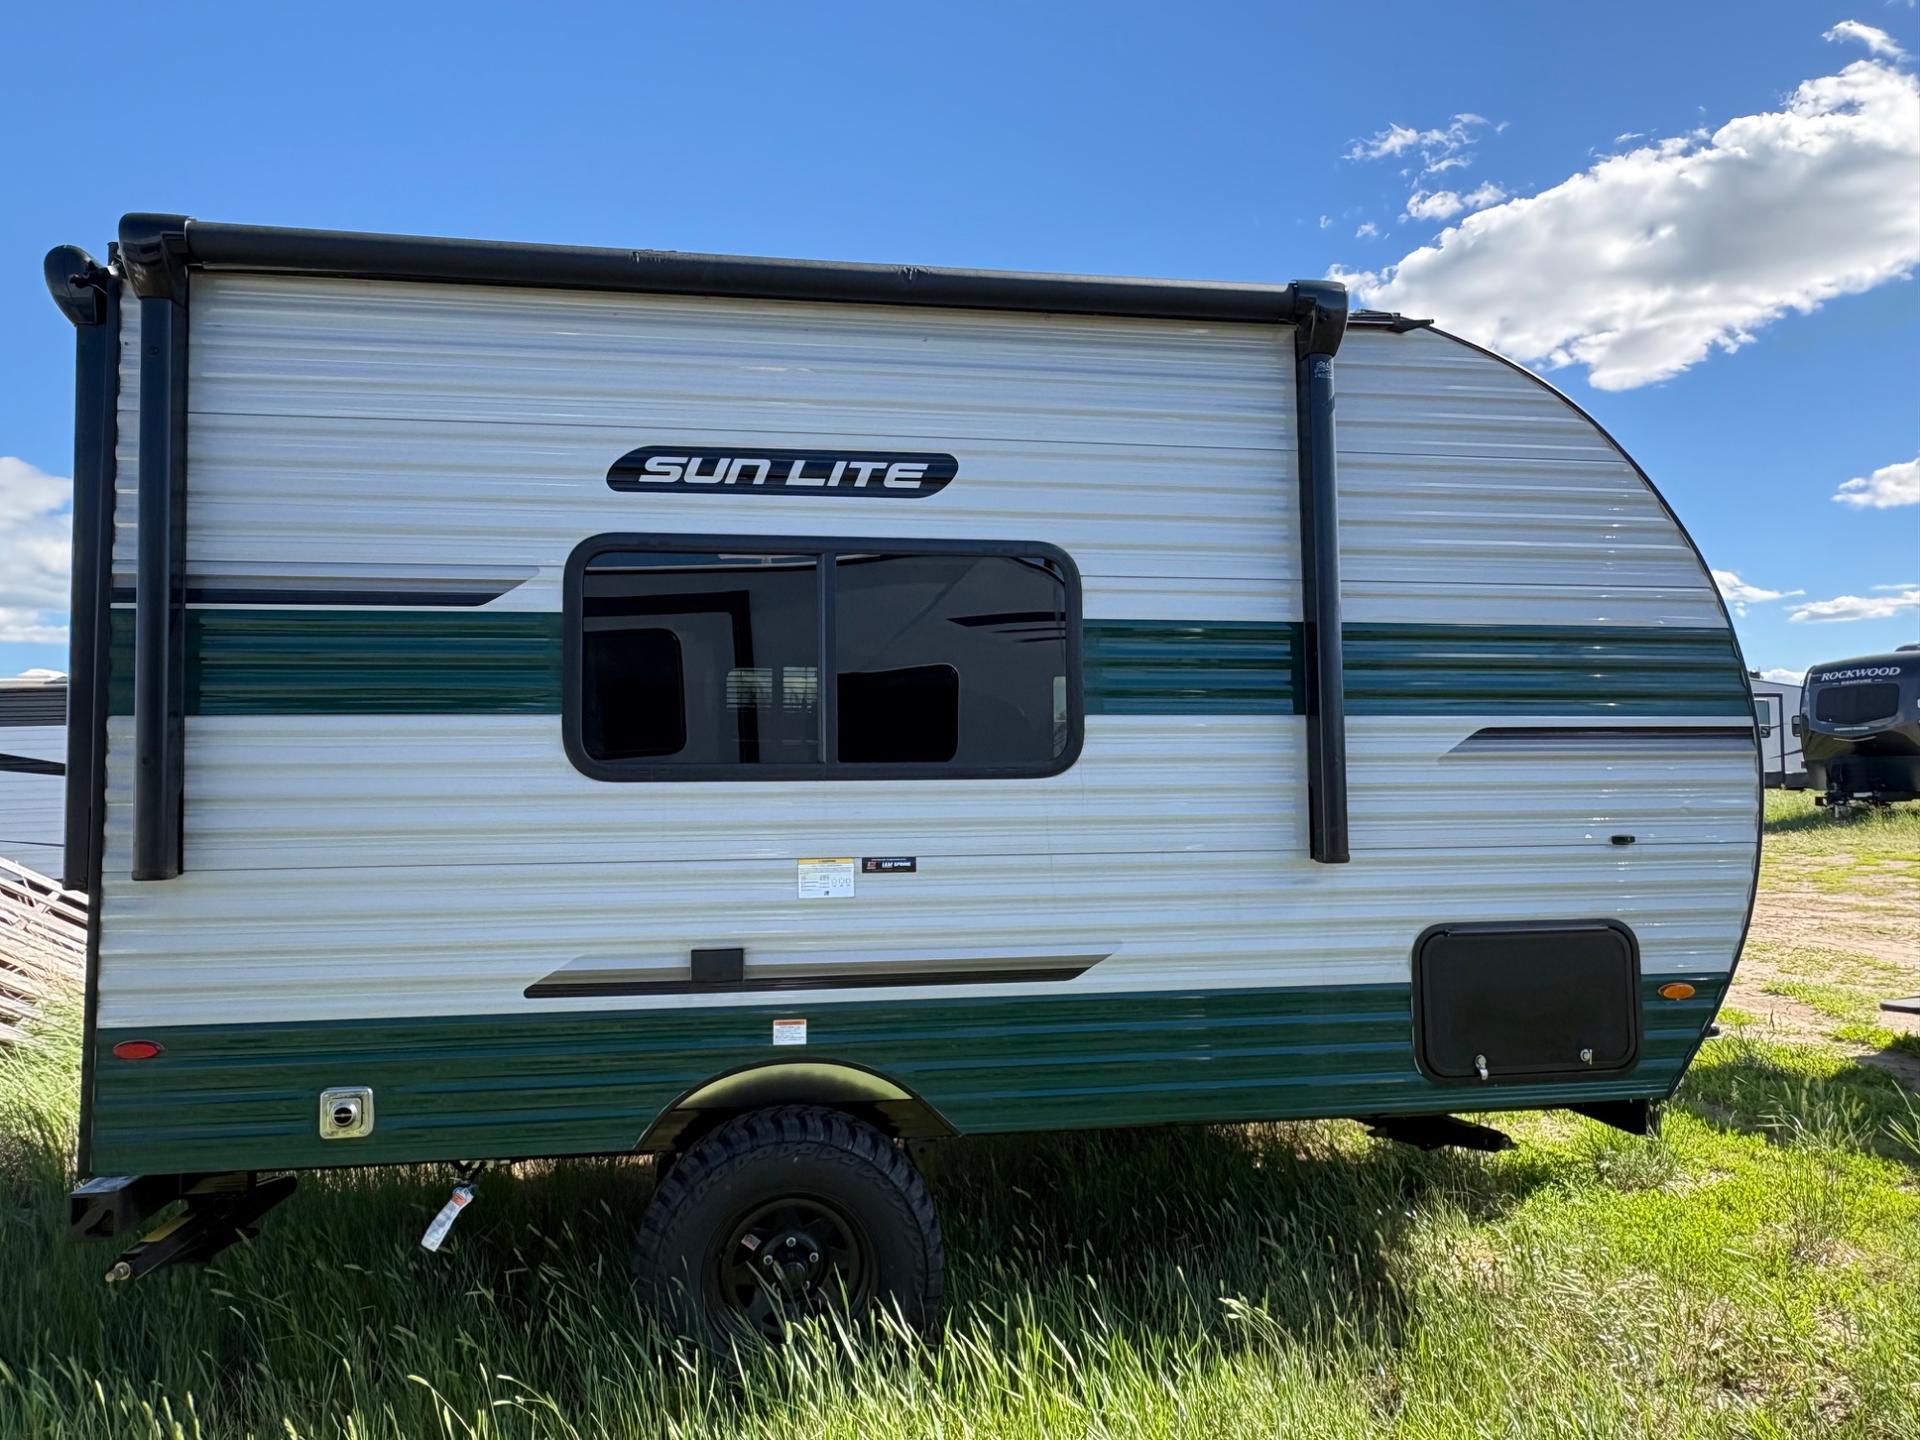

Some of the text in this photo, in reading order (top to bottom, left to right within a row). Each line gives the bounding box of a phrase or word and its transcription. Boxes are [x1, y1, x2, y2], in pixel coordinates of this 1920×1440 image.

[638, 456, 929, 489] SUN LITE
[1820, 667, 1901, 682] ROCKWOOD
